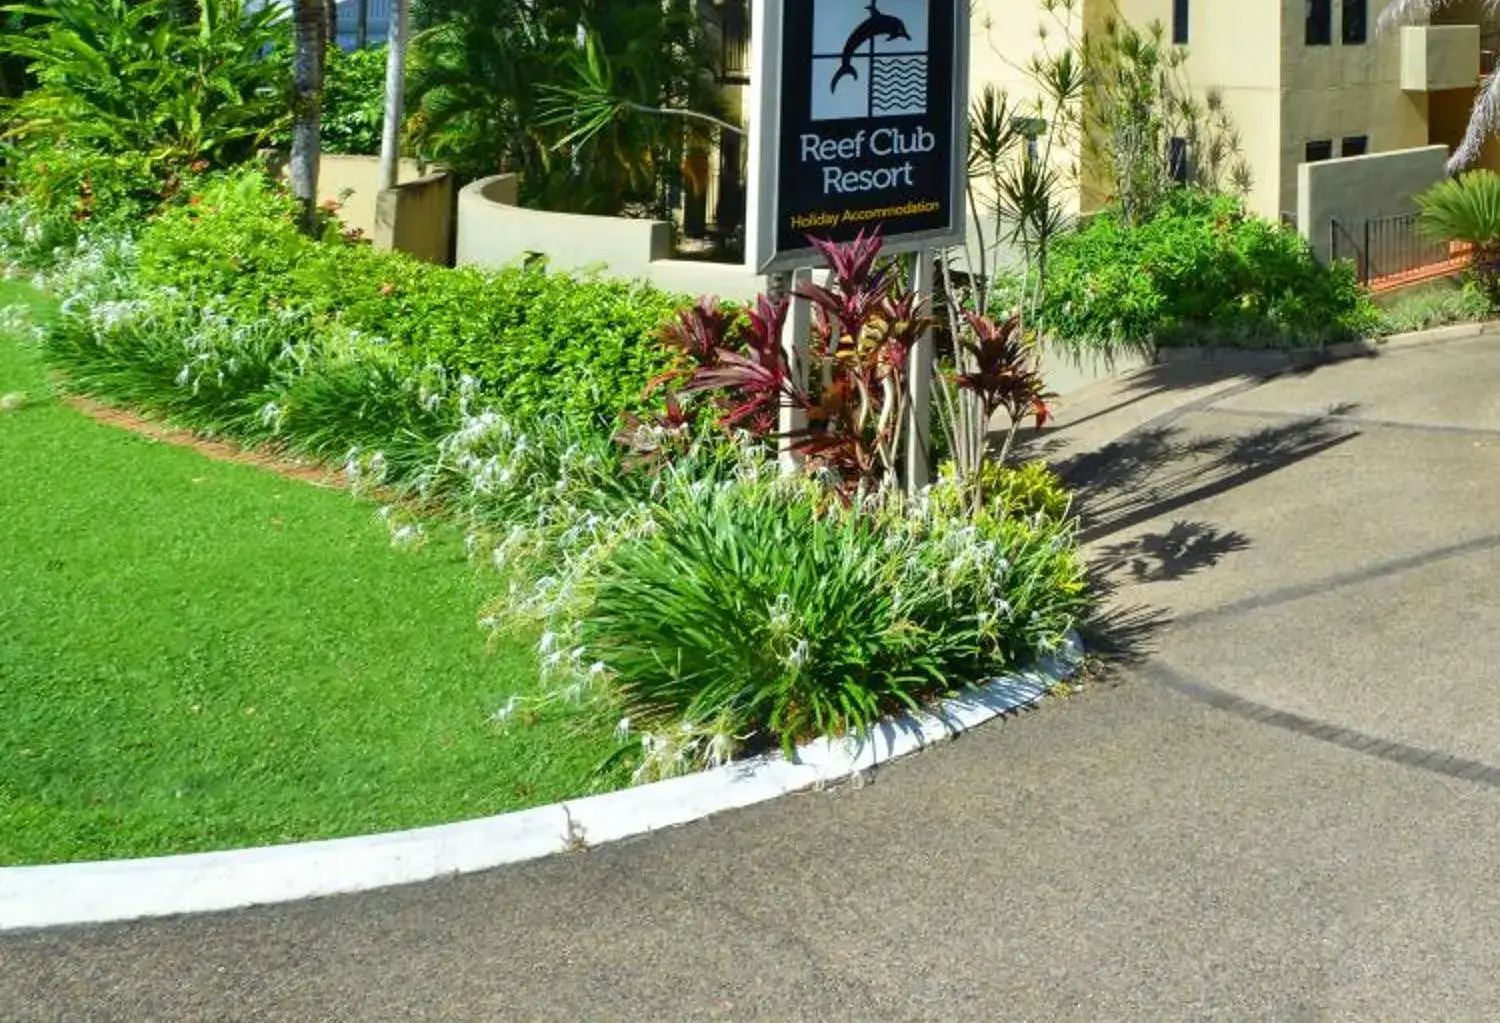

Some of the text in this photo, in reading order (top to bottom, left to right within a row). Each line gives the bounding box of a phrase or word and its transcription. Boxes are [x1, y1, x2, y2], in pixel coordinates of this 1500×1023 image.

[800, 126, 935, 161] Reef Club
[822, 161, 913, 194] Resort
[790, 200, 940, 229] Holiday Accommodation
